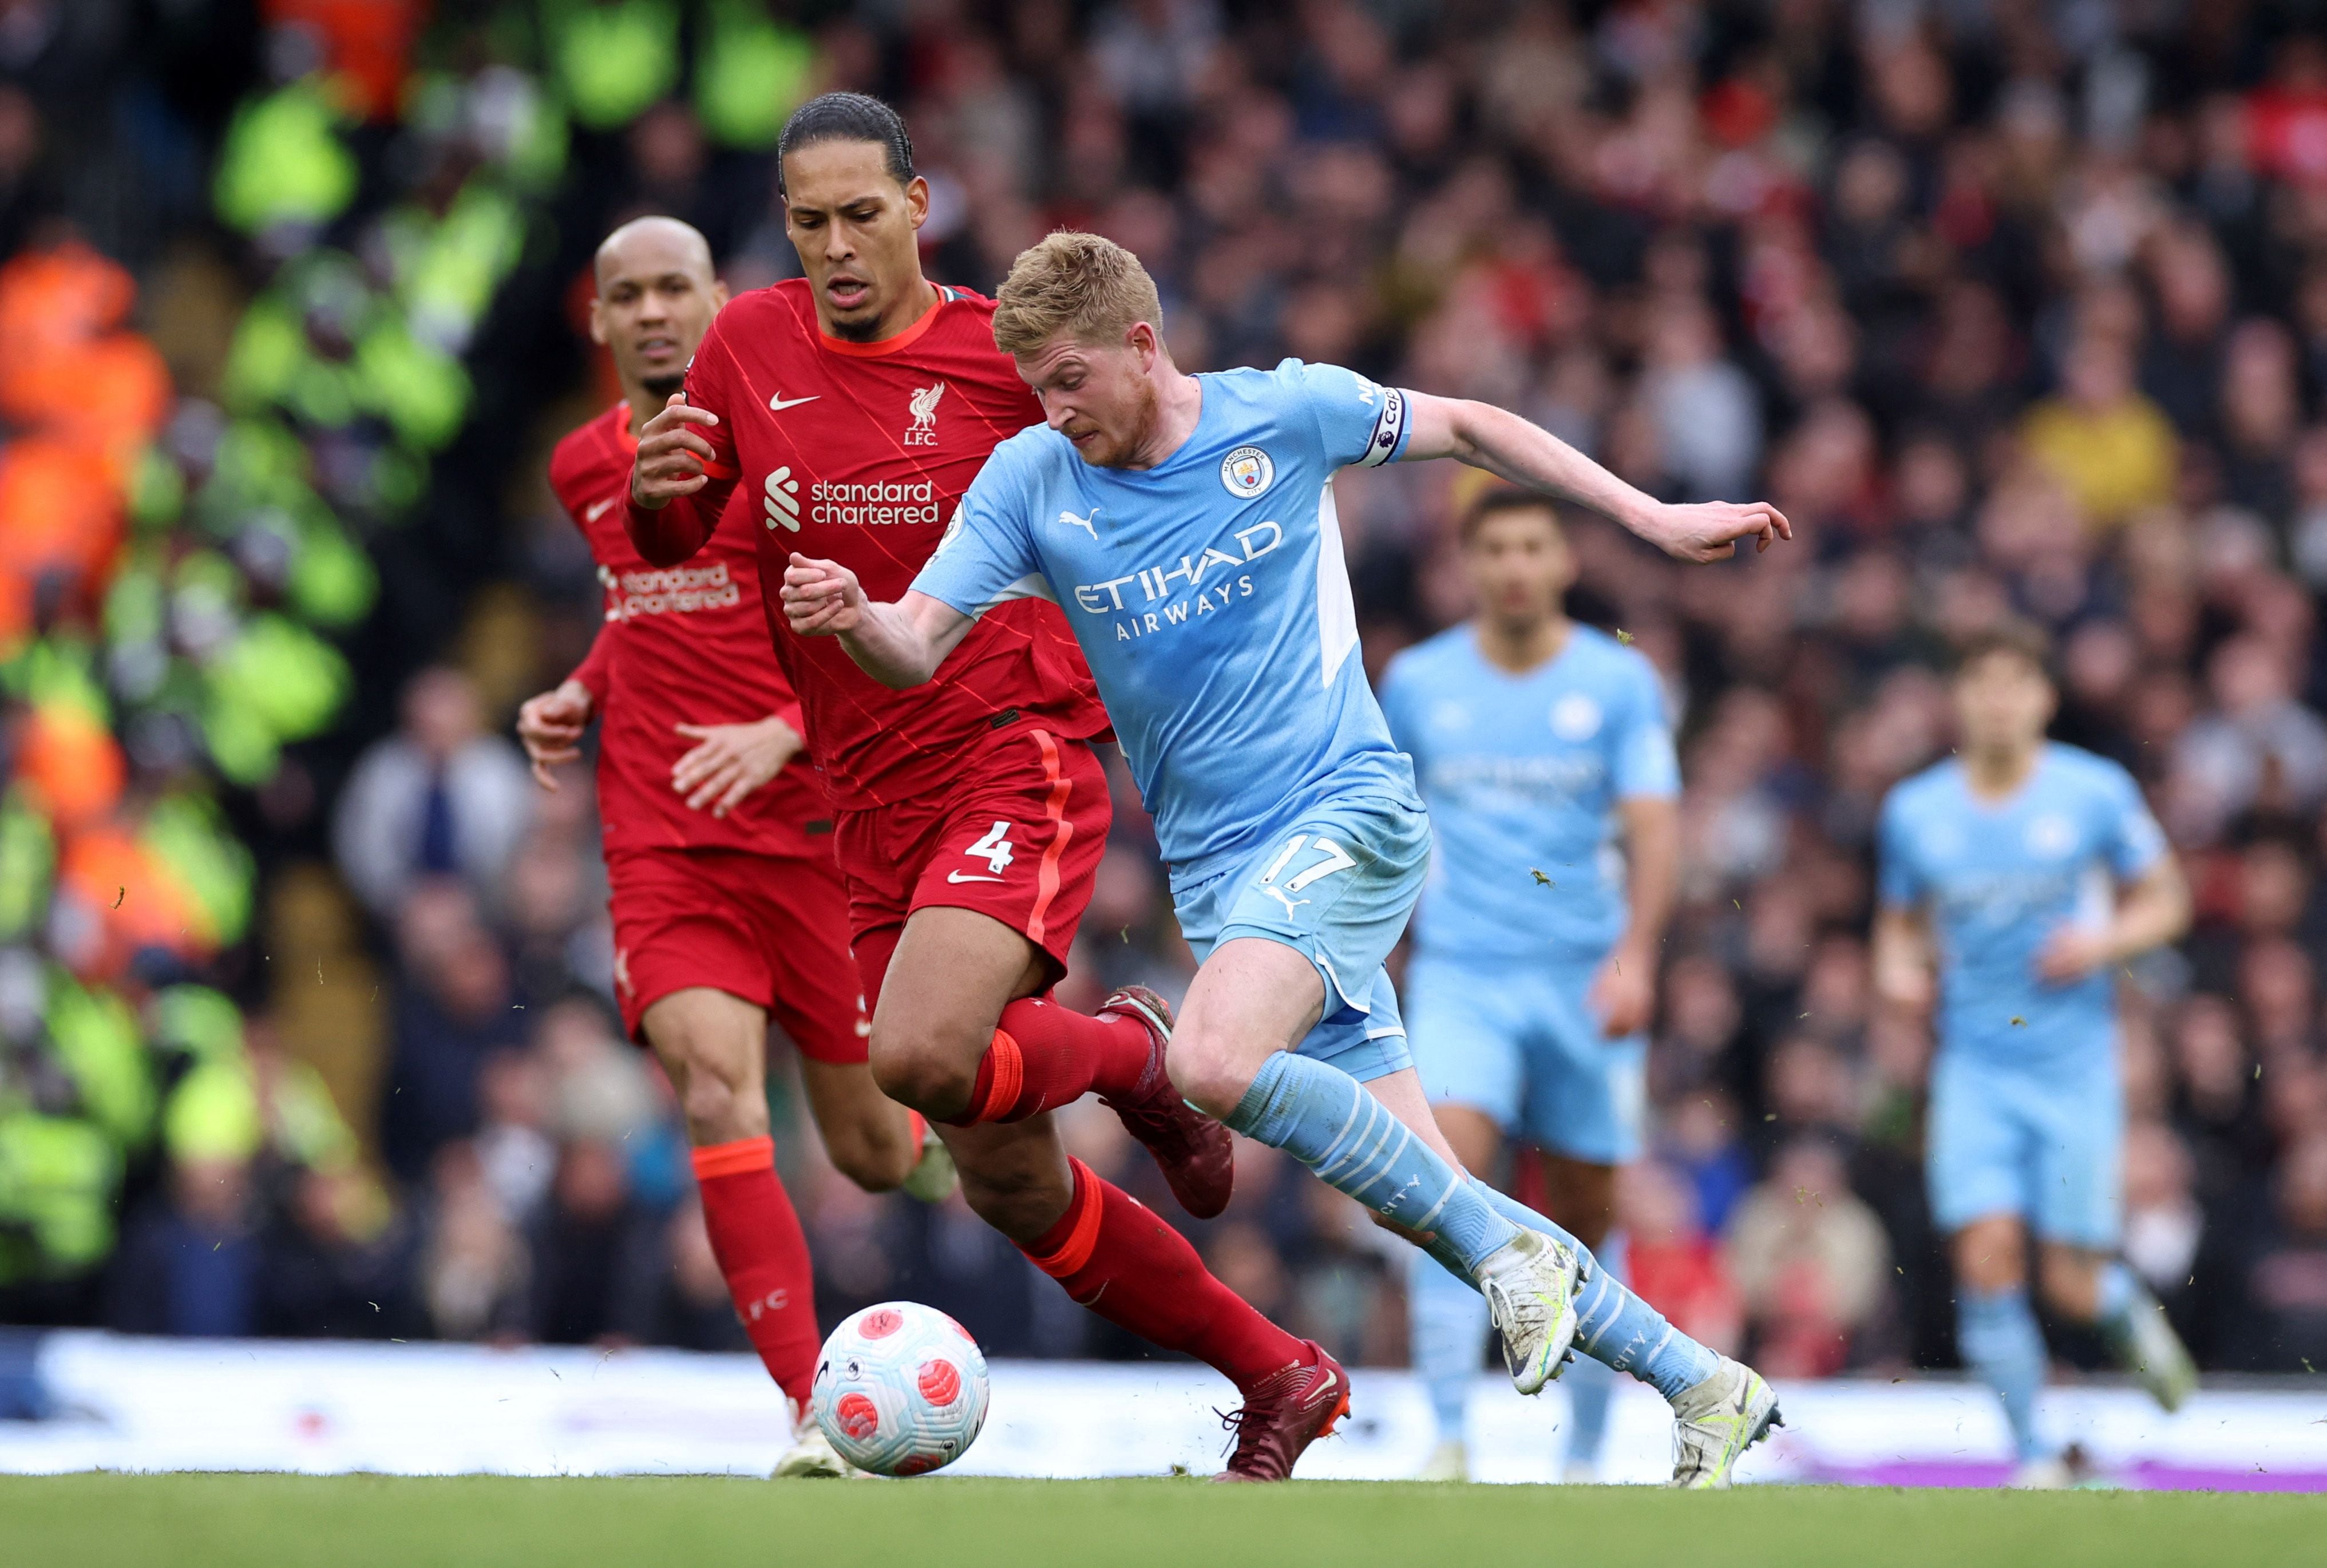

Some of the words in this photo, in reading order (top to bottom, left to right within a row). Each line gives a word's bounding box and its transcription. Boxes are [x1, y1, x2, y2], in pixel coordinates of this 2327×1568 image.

[904, 432, 938, 446] L.F.C.
[1224, 449, 1265, 472] MANCHESTER
[812, 480, 932, 502] standard
[1246, 486, 1262, 496] CITY
[812, 501, 939, 524] chartered
[1074, 521, 1283, 614] ETIHAD
[1116, 575, 1253, 642] AIRWAYS
[965, 821, 1014, 874] 4
[1258, 834, 1358, 893] 17
[1380, 1174, 1421, 1214] CITY
[1613, 1329, 1647, 1370] CITY
